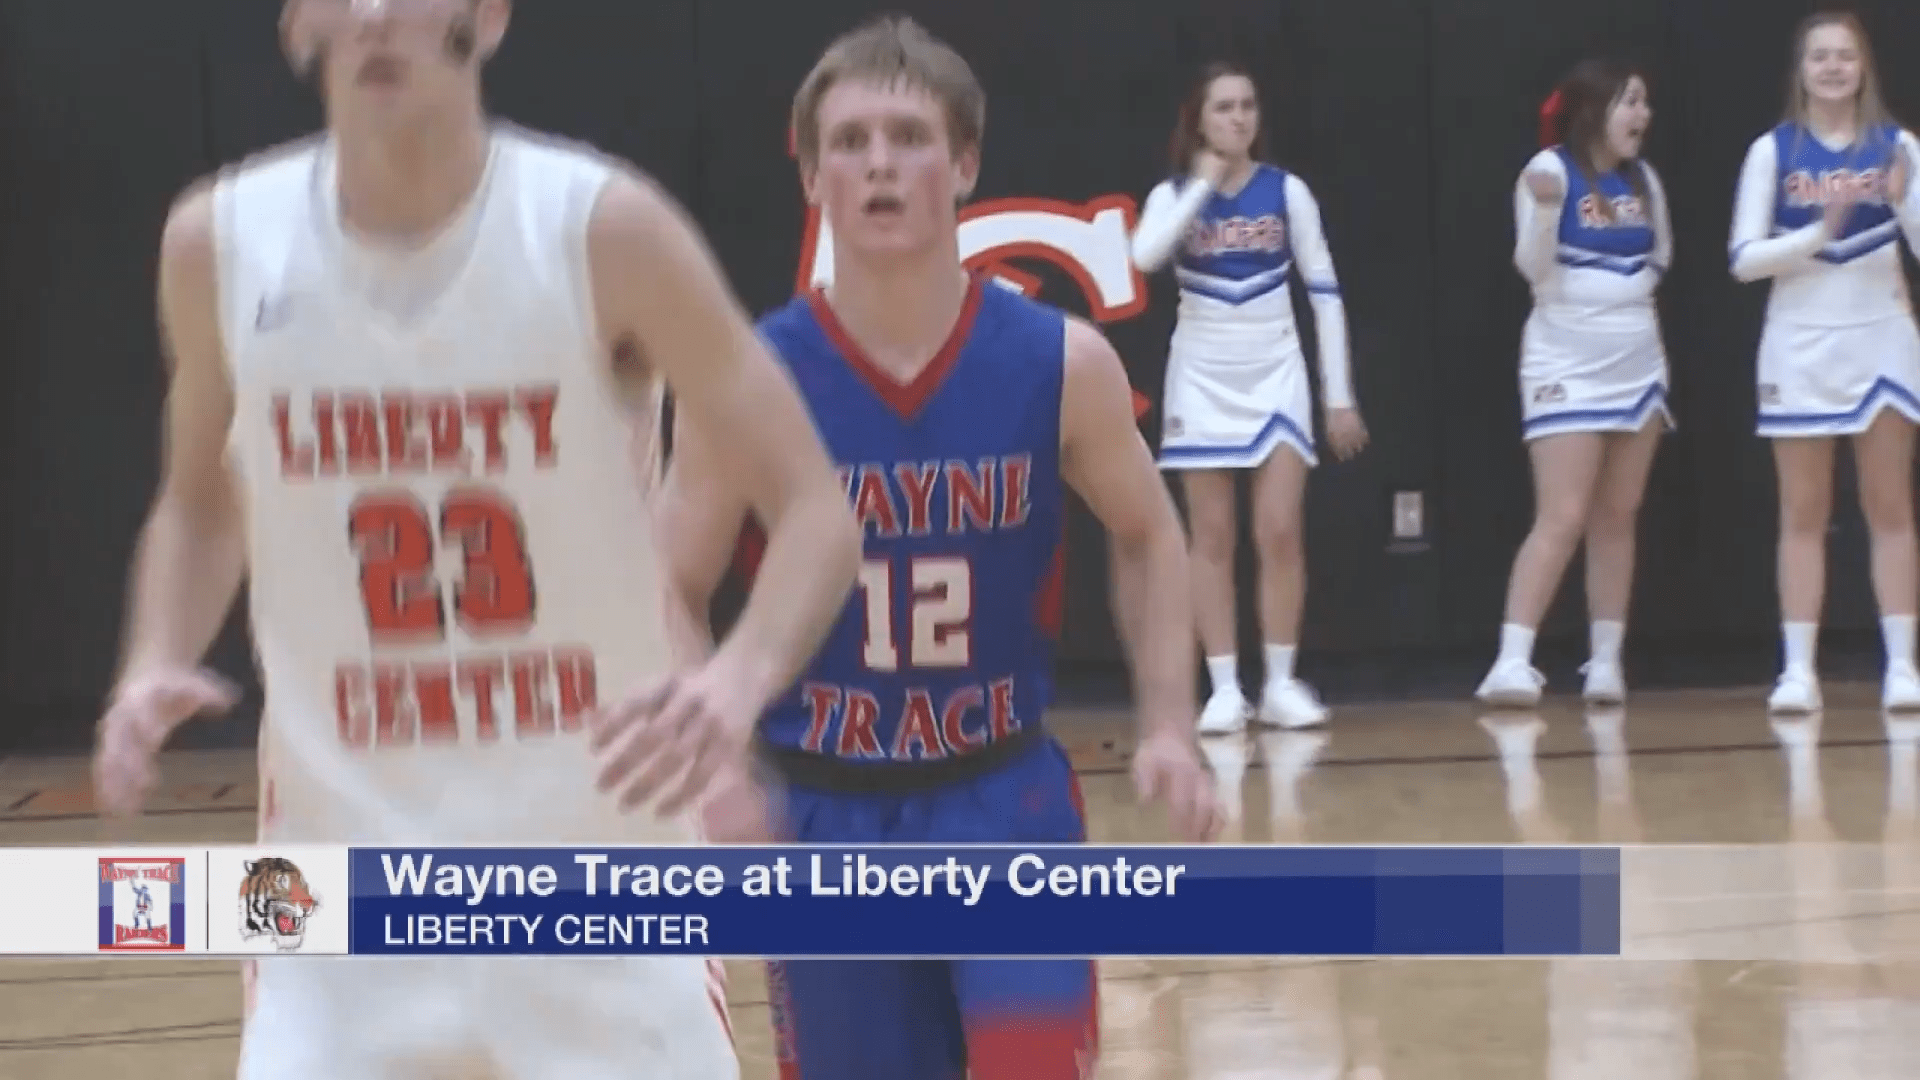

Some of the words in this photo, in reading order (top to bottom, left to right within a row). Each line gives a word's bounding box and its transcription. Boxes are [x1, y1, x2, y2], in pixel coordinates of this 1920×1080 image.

[271, 382, 560, 483] LIBERTY
[838, 453, 1032, 537] AYNE
[349, 488, 538, 648] 23
[858, 556, 973, 673] 12
[334, 645, 598, 750] CENTER
[801, 675, 1022, 760] TRACE
